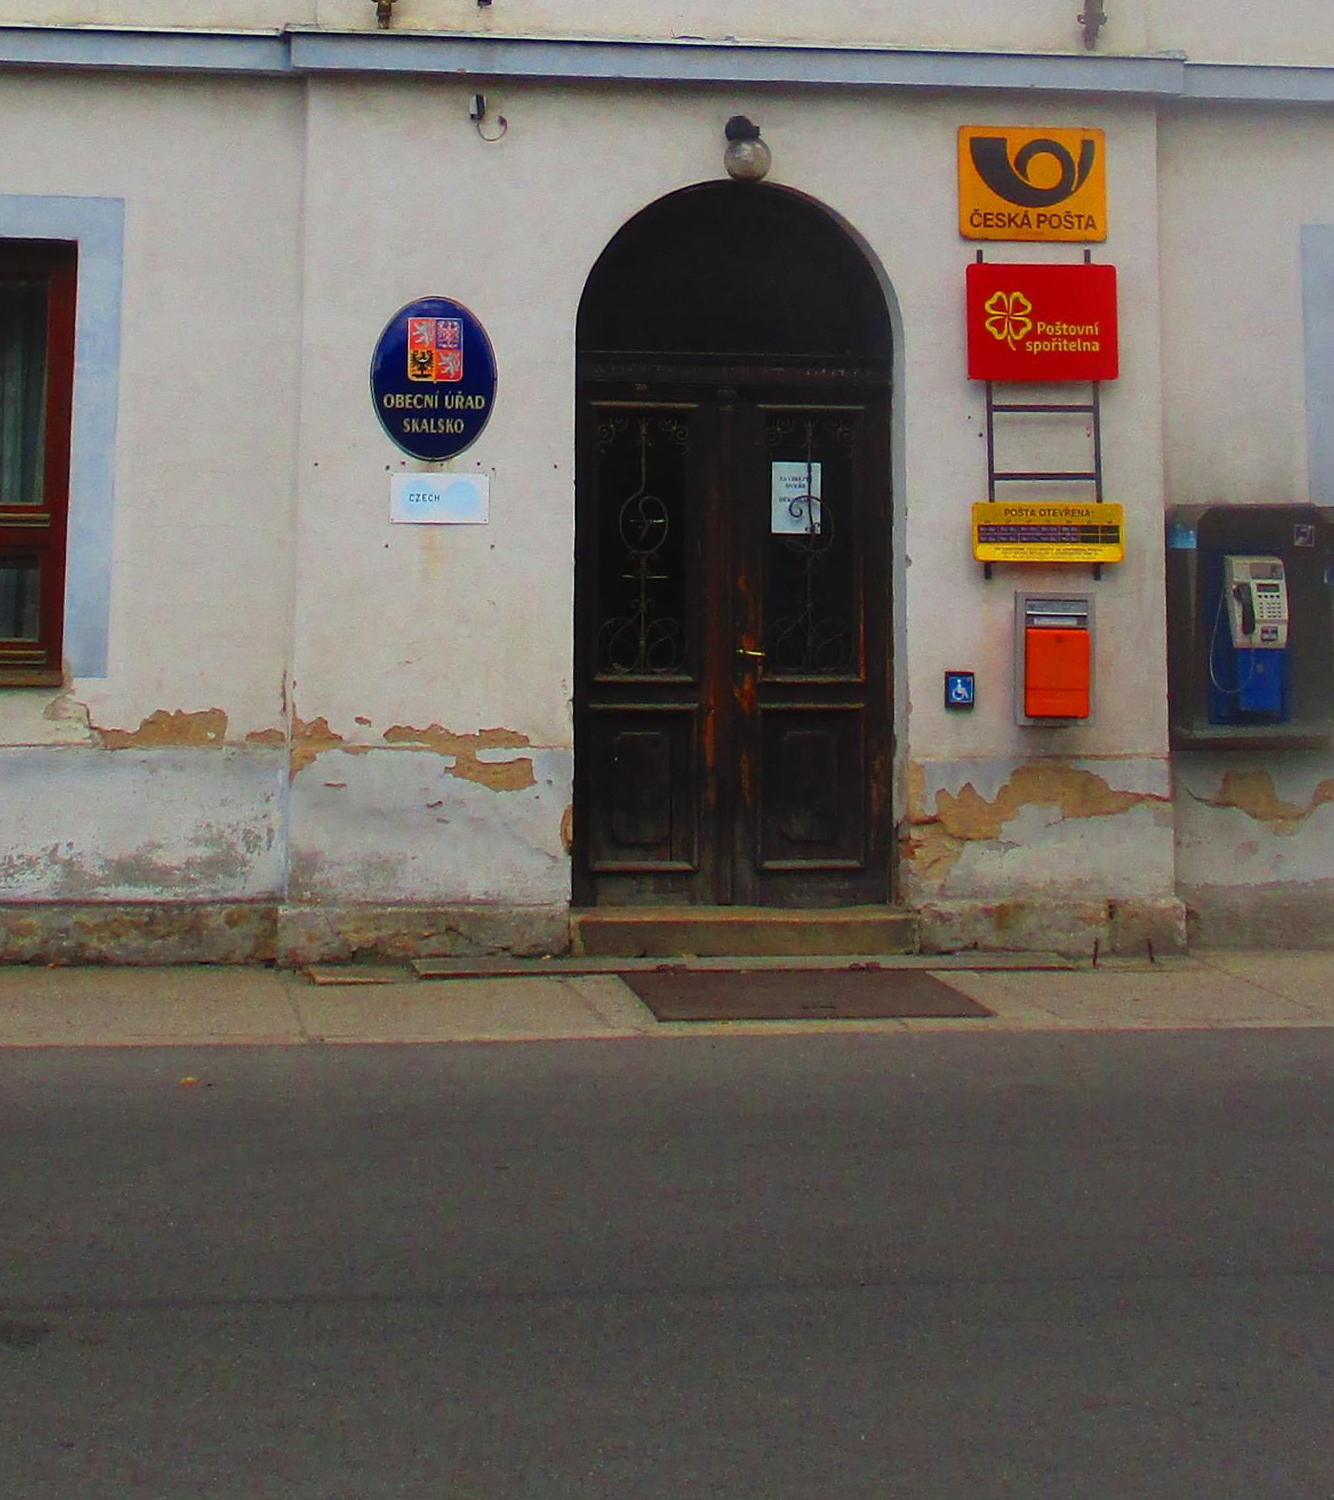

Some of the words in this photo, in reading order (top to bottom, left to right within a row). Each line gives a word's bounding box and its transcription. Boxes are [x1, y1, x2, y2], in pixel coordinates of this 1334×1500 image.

[970, 209, 1032, 228] ČESKÁ
[1036, 211, 1097, 230] POŠTA
[1037, 321, 1099, 336] Poštovní
[1025, 338, 1100, 355] spořitelna
[383, 390, 439, 410] OBECNÍ
[444, 390, 485, 410] ÚŘAD
[403, 418, 464, 434] SKALSKO
[408, 493, 440, 502] CZECH
[1004, 507, 1036, 517] POŠTA
